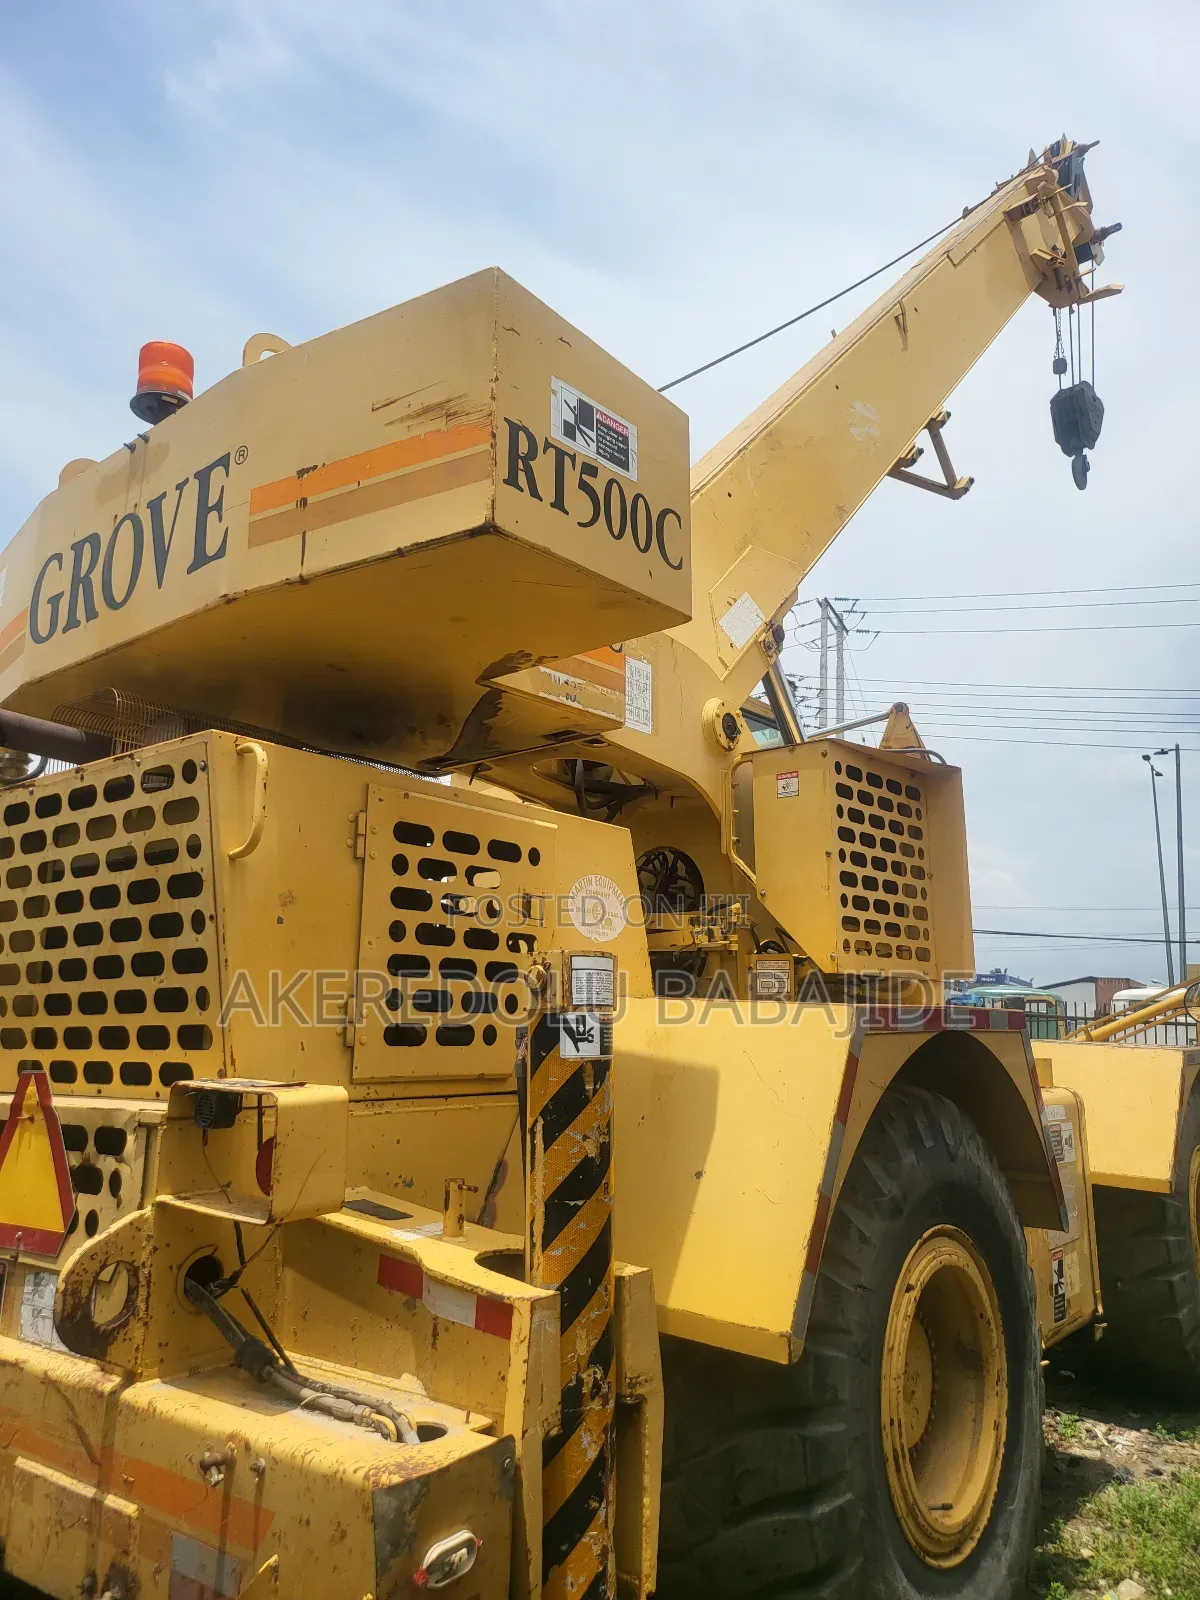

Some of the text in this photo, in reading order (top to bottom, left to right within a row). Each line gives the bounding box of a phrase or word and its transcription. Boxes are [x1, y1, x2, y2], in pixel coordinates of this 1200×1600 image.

[602, 414, 629, 437] DANGER
[502, 417, 684, 570] RT500C
[30, 452, 231, 644] GROVE
[570, 876, 593, 903] MARTIN
